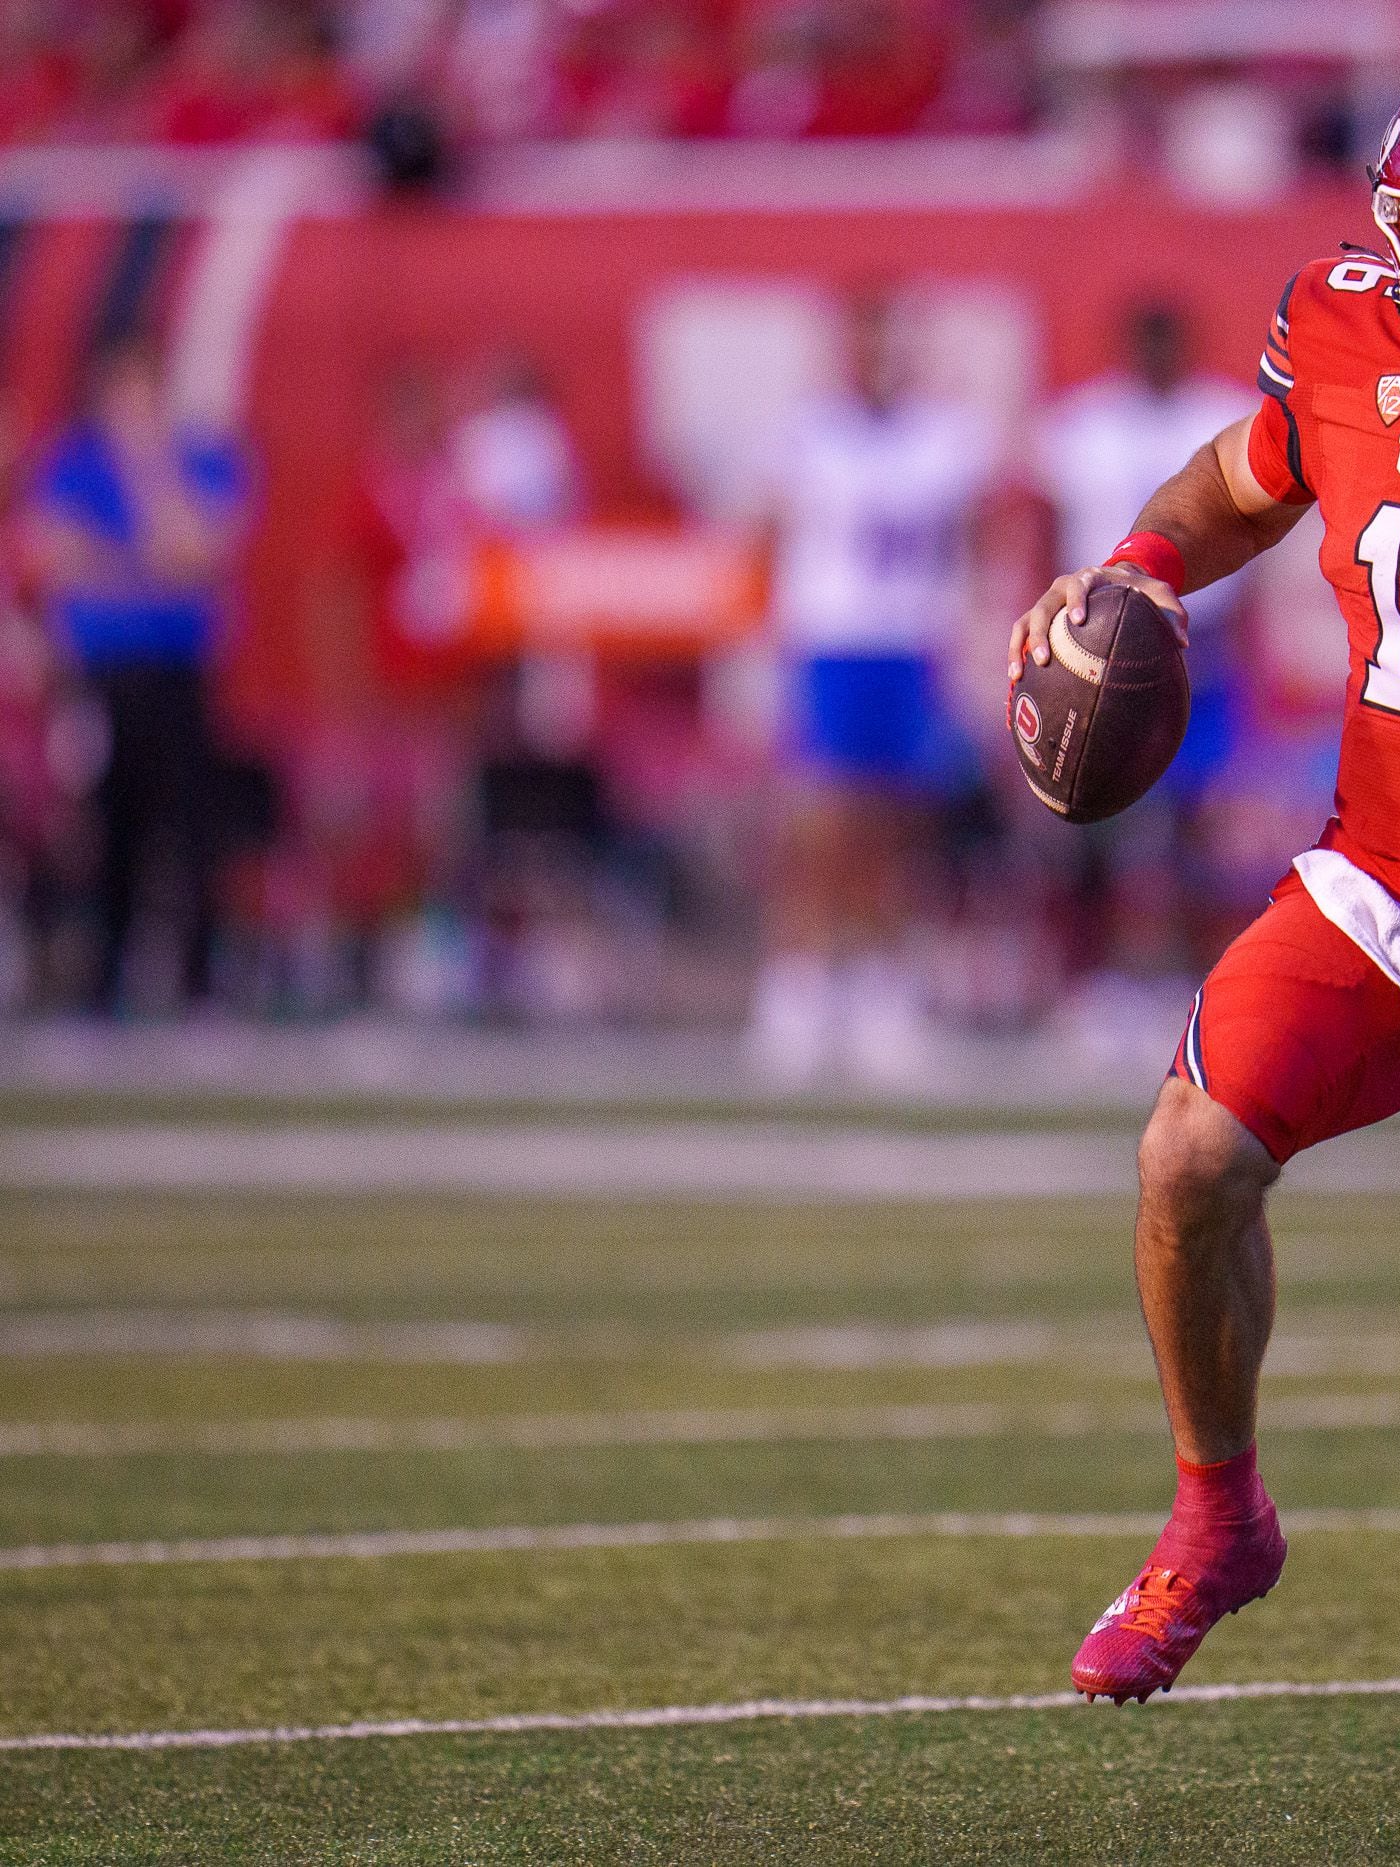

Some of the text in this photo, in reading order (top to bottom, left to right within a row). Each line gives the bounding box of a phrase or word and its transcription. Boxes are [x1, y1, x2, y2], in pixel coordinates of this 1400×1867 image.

[1017, 698, 1038, 738] U
[1052, 708, 1078, 783] TEAM ISSUE
